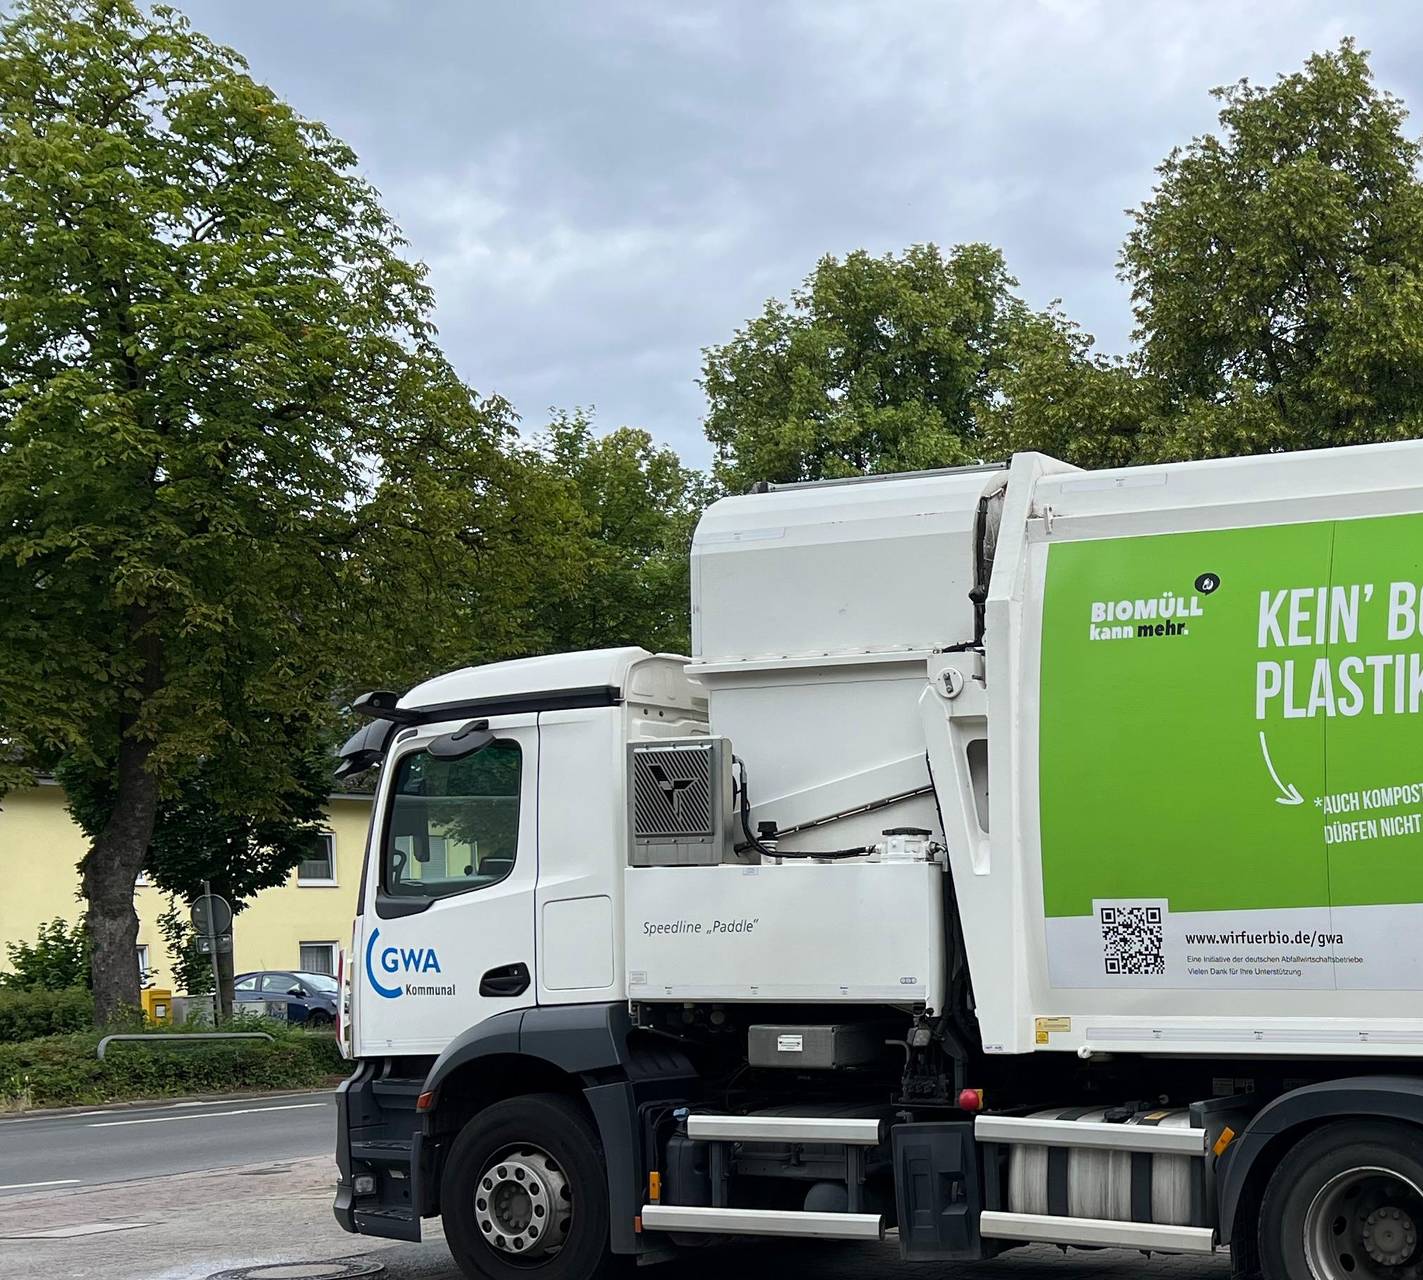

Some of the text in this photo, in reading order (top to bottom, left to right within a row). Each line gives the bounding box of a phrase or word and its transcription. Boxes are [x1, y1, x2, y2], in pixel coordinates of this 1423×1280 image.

[1091, 591, 1204, 623] BIOMÜLL
[1089, 619, 1189, 641] kann mehr.
[1323, 820, 1378, 844] DÜRFEN
[1380, 813, 1422, 837] NICHT
[643, 920, 702, 937] Speedline
[1185, 930, 1344, 948] www.wirfuerbio.de/gwa
[381, 947, 442, 973] GWA
[1187, 955, 1202, 963] Eine
[1203, 955, 1231, 963] Initiative
[1232, 955, 1243, 963] der
[1244, 955, 1280, 963] deutschen
[1188, 967, 1209, 975] Vielen
[1210, 967, 1228, 975] Dank
[1229, 967, 1239, 975] für
[1240, 967, 1253, 975] Ihre
[405, 983, 456, 996] Kommunal
